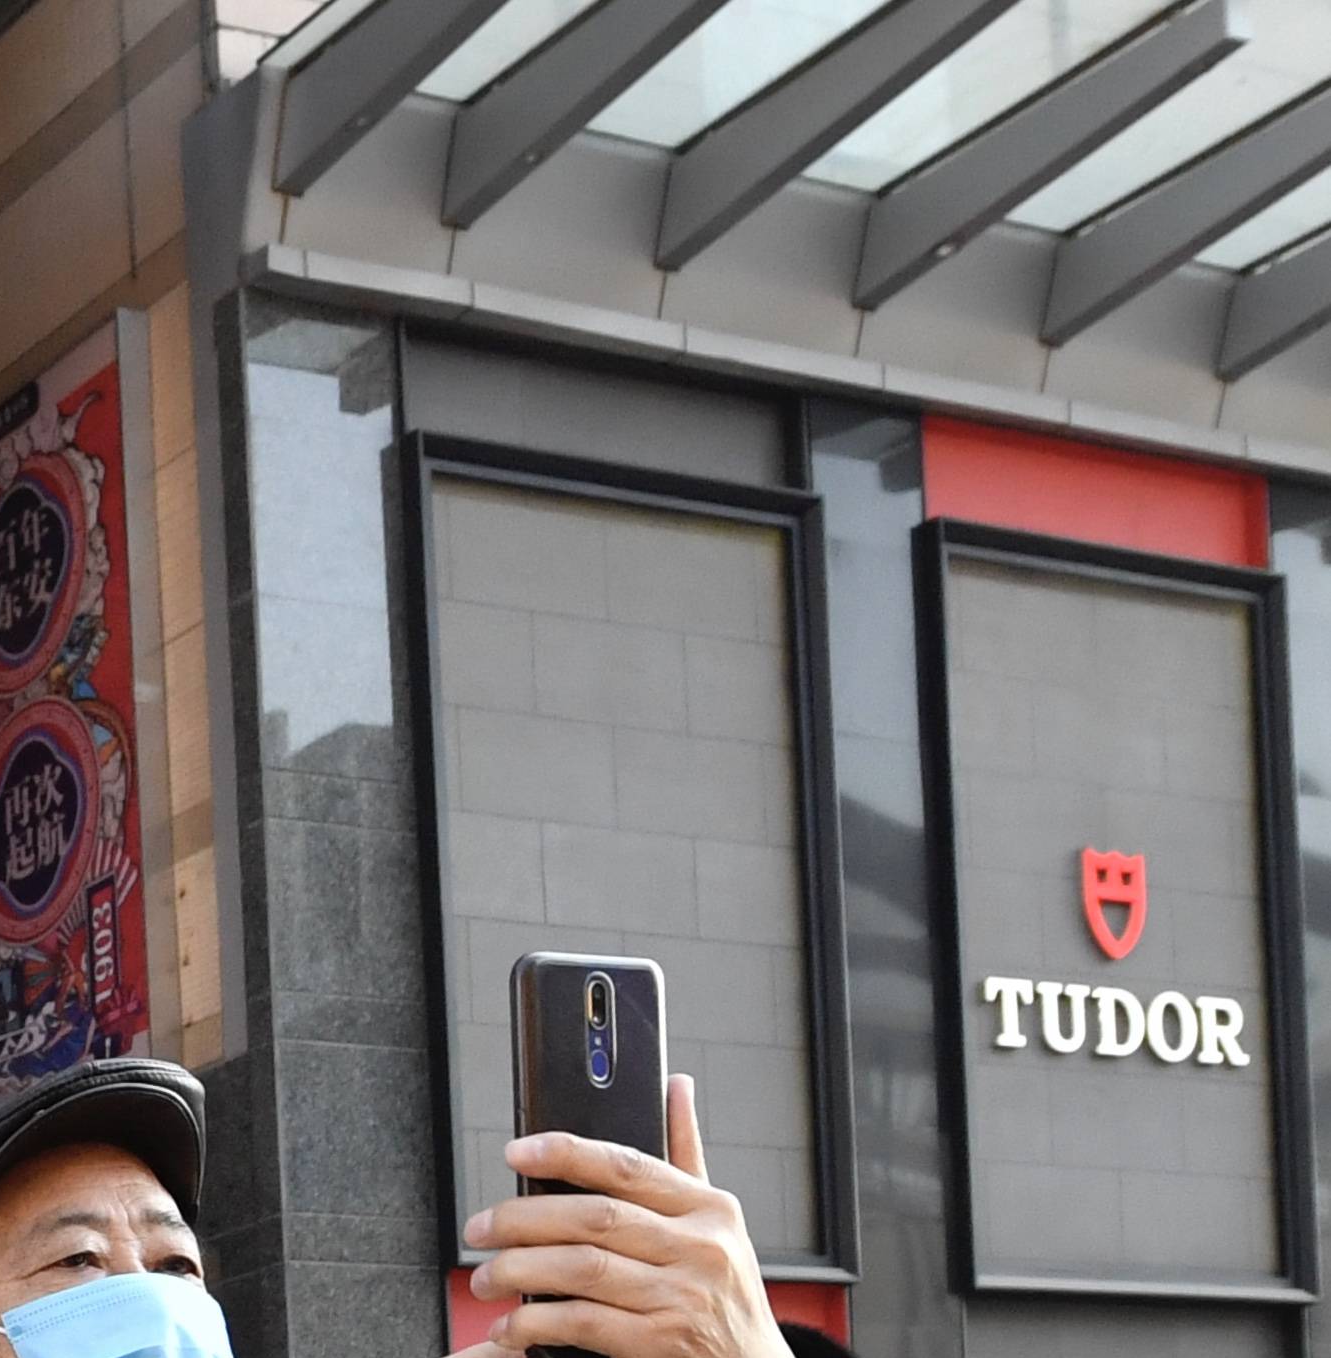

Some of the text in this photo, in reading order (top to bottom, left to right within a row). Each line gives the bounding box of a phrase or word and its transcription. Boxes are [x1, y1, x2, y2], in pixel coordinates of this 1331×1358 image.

[4, 763, 65, 835] 再次
[91, 901, 114, 1004] 1903
[983, 975, 1251, 1067] TUDOR
